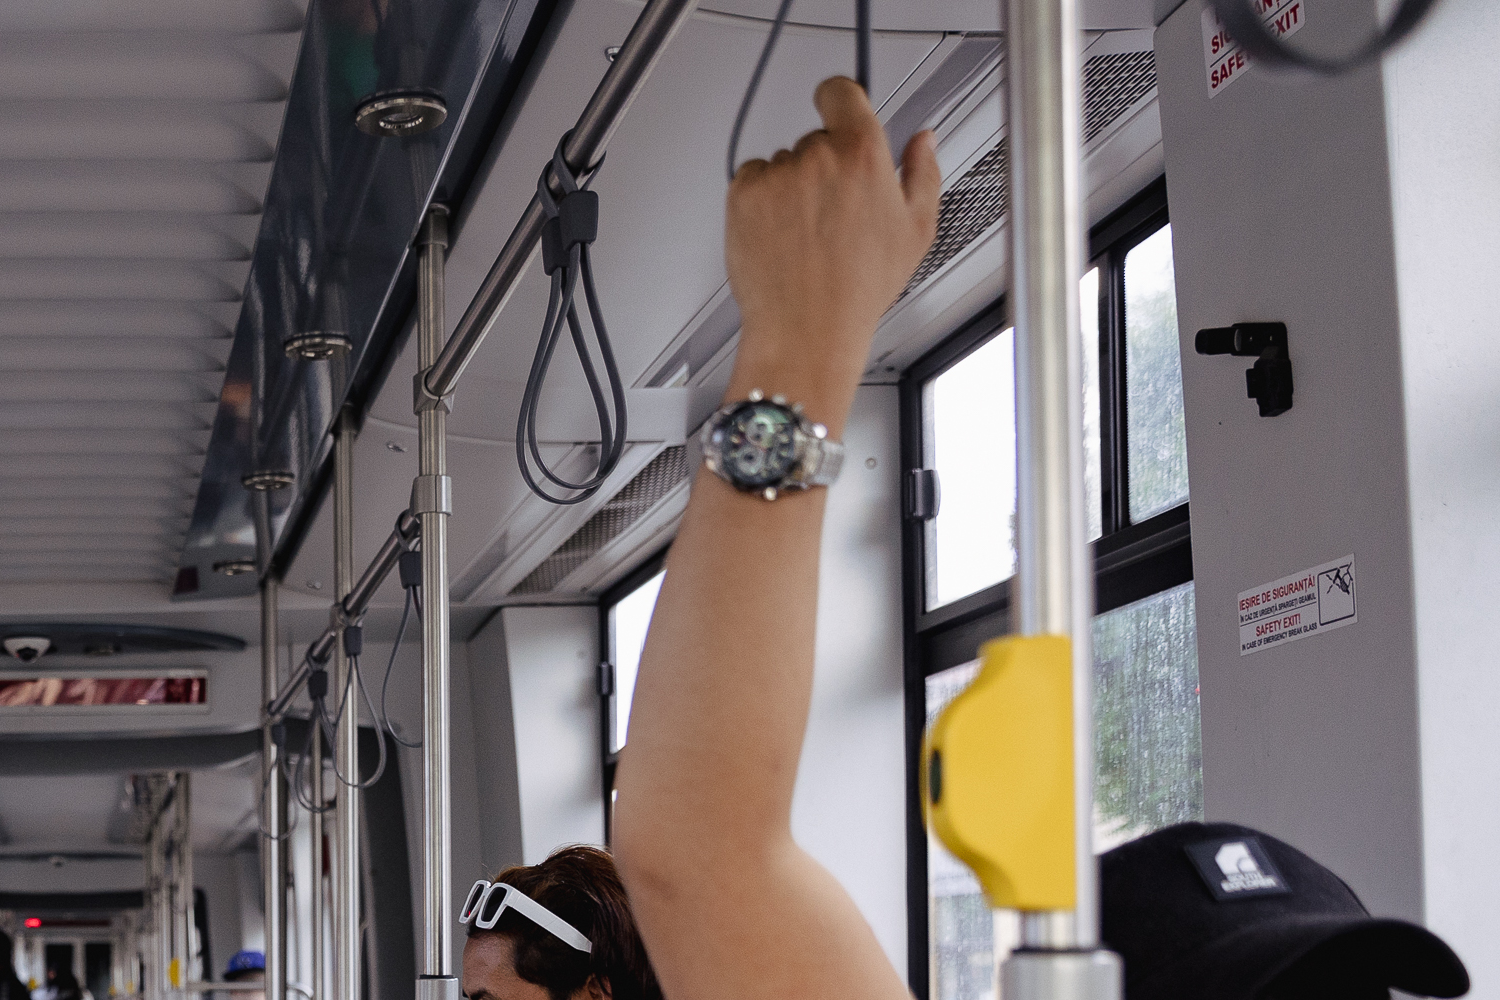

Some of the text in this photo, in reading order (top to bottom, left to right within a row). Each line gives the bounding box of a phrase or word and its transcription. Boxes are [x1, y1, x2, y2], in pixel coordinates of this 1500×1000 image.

[1211, 50, 1250, 89] SAFE
[1240, 574, 1316, 612] IEȘIRE DE SIGURANȚĂ!
[1253, 610, 1258, 619] DE
[1299, 593, 1316, 604] GEAMUL
[1247, 641, 1257, 650] CASE
[1257, 638, 1263, 646] OF
[1263, 631, 1288, 645] EMERGENCY
[1288, 627, 1302, 638] BREAK
[1303, 622, 1317, 633] GLASS
[1256, 613, 1301, 637] SAFETY EXIT!
